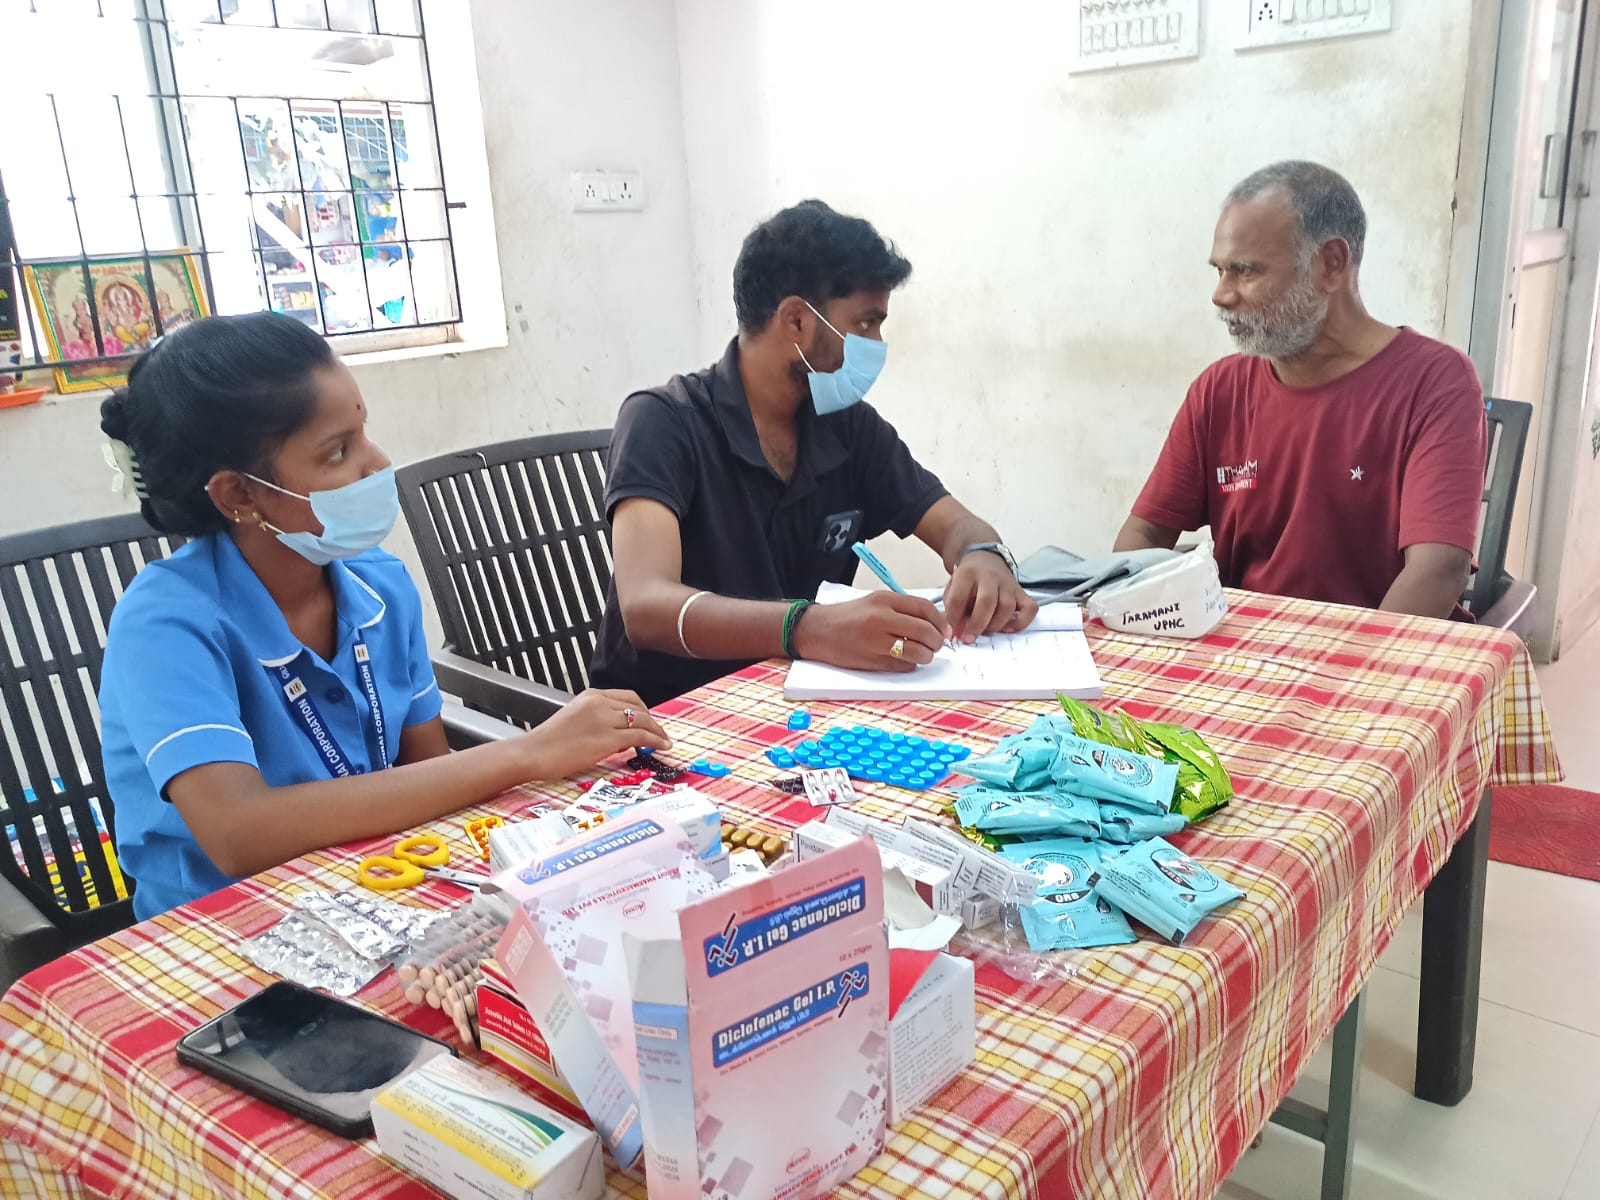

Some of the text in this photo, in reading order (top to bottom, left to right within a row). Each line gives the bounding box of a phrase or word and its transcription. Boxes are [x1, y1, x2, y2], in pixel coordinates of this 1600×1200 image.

[1154, 618, 1184, 631] UPHC
[360, 665, 382, 733] CORPORATION
[298, 698, 340, 764] CORPORATION
[574, 850, 597, 862] Gel
[596, 826, 660, 852] Diclofenac
[1055, 892, 1079, 903] ORS
[742, 895, 860, 957] Diclofenac Gel I.P.
[718, 980, 836, 1048] Diclofenac Gel I.P.
